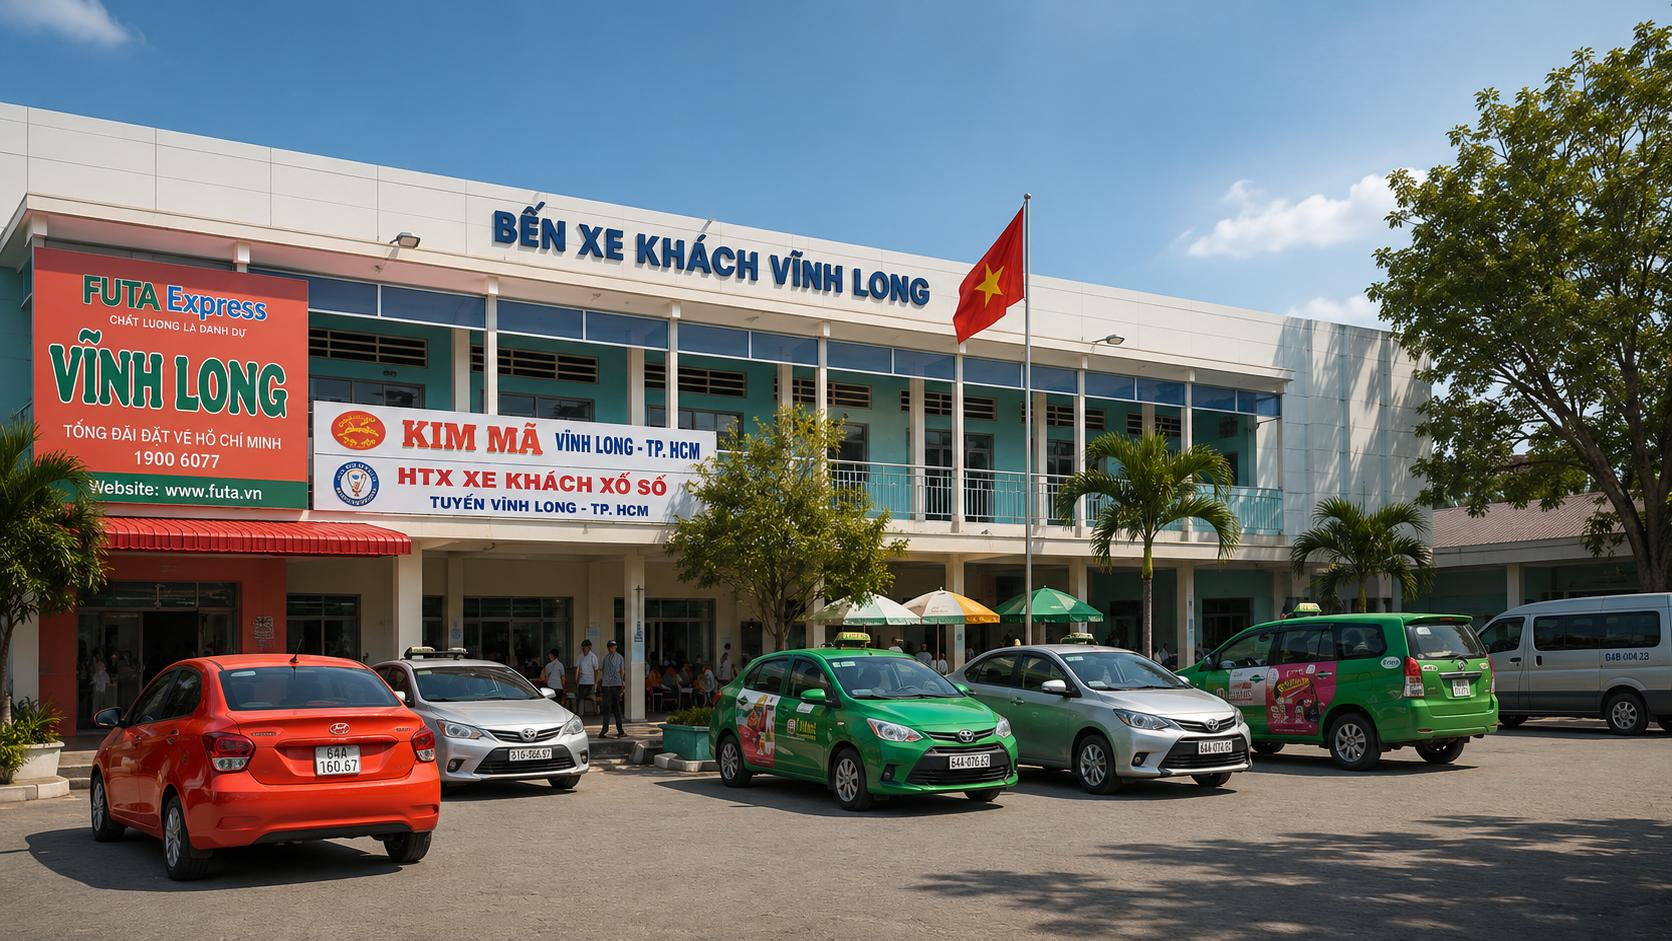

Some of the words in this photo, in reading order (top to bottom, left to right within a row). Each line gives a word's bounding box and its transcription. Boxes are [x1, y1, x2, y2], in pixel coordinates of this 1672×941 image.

[494, 201, 566, 252] BẾN
[578, 223, 624, 261] XE
[637, 233, 758, 281] KHÁCH
[770, 250, 843, 293] VĨNH
[853, 268, 930, 306] LONG
[83, 274, 162, 312] FUTA
[167, 284, 268, 321] Express
[49, 328, 164, 410] VĨNH
[174, 355, 288, 419] LONG
[220, 431, 243, 448] CHÍ
[247, 435, 281, 450] MINH
[402, 419, 477, 451] KIM
[486, 422, 544, 455] MÃ
[596, 435, 633, 456] LONG
[646, 439, 666, 458] TP.
[669, 441, 700, 460] HCM
[134, 451, 175, 467] 1900
[180, 453, 220, 469] 6077
[165, 483, 262, 500] www.futa.vn
[398, 467, 453, 486] HTX
[463, 470, 497, 488] XE
[506, 470, 592, 493] KHÁCH
[600, 472, 631, 495] XỐ
[637, 474, 667, 496] SỐ
[430, 493, 485, 510] TUYẾN
[535, 501, 577, 514] LONG
[591, 503, 612, 516] TP.
[617, 504, 649, 517] HCM
[327, 747, 347, 759] 64A
[320, 759, 358, 773] 160.67
